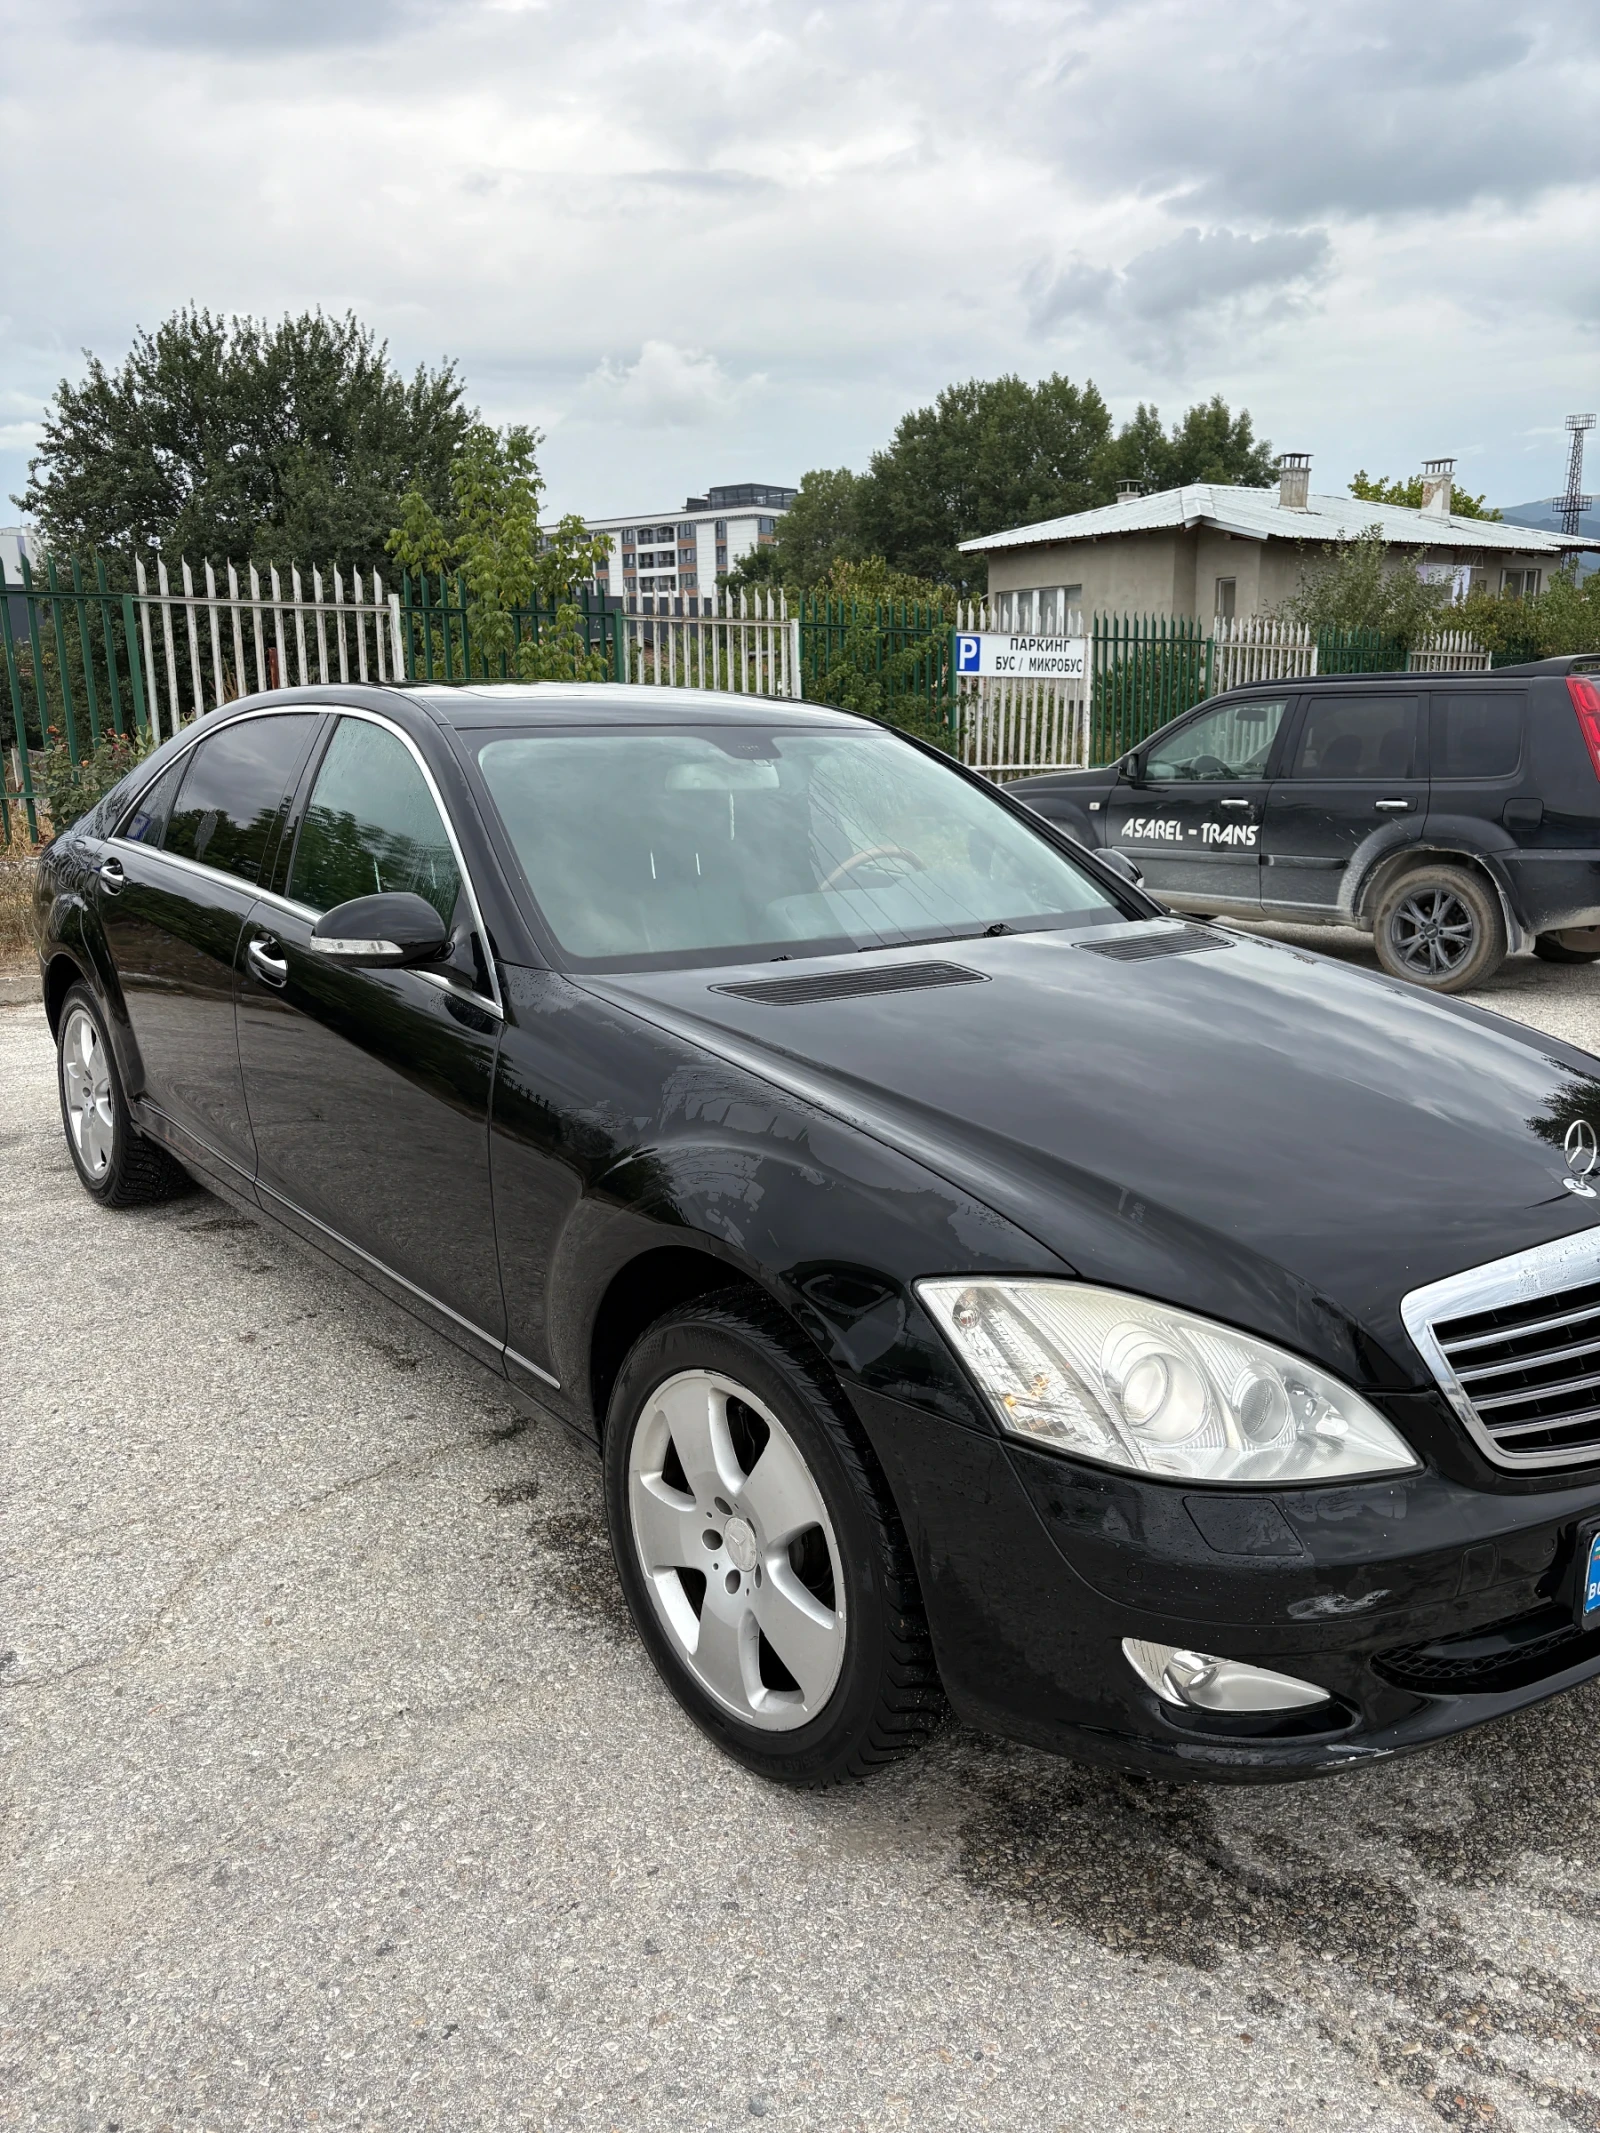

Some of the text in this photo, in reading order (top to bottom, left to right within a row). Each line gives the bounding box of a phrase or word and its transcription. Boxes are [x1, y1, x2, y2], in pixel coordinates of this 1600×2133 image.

[959, 638, 978, 670] P
[1010, 637, 1071, 652] ПАРКИНГ
[995, 656, 1083, 673] БУС / МИКРОБУС
[1121, 818, 1260, 846] ASAREL - TRANS
